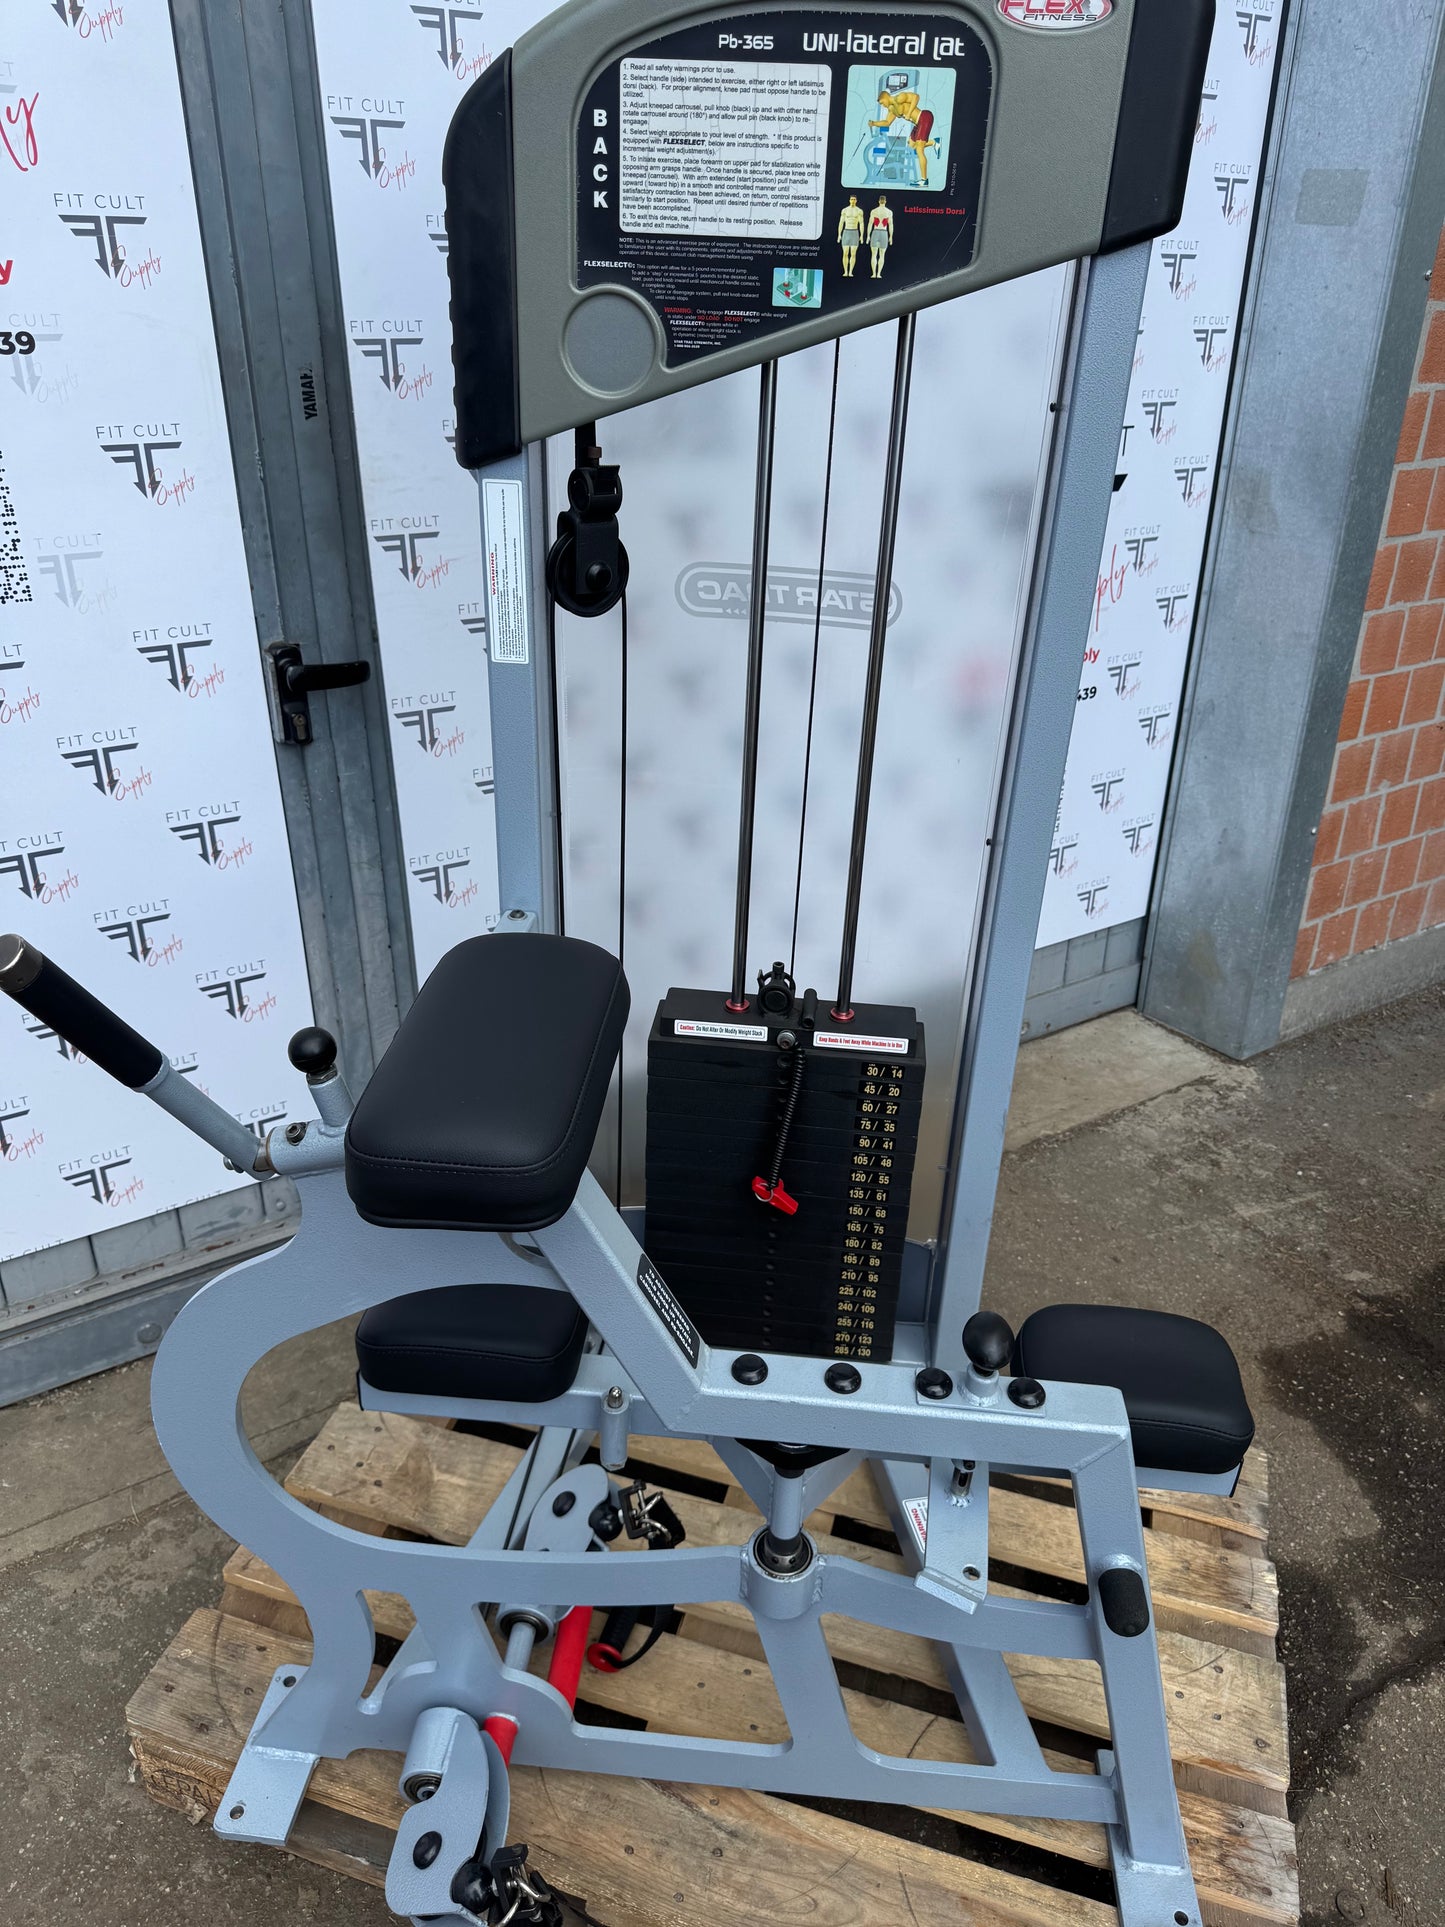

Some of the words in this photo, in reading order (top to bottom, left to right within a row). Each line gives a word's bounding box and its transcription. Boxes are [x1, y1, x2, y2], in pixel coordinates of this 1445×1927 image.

[718, 33, 774, 50] Pb-365
[803, 29, 926, 55] UNI-lateral
[630, 63, 646, 71] Read
[674, 65, 700, 73] warnings
[327, 96, 353, 111] FIT
[362, 98, 405, 114] CULT
[1214, 163, 1228, 173] FIT
[1230, 164, 1252, 174] CULT
[54, 193, 84, 208] FIT
[94, 195, 144, 210] CULT
[904, 206, 944, 214] Latissimus
[1161, 240, 1174, 249] FIT
[1177, 240, 1199, 250] CULT
[350, 320, 374, 333] FIT
[382, 320, 423, 332] CULT
[1193, 316, 1208, 325] FIT
[1210, 316, 1229, 325] CULT
[1142, 389, 1156, 398] FIT
[1159, 389, 1178, 398] CULT
[96, 425, 124, 439] FIT
[133, 423, 180, 437] CULT
[1174, 457, 1186, 465] FIT
[1189, 455, 1209, 464] CULT
[371, 519, 394, 531] FIT
[401, 515, 439, 528] CULT
[1125, 528, 1137, 536] FIT
[1140, 525, 1160, 535] CULT
[458, 603, 479, 615] FIT
[133, 629, 159, 642] FIT
[168, 623, 211, 638] CULT
[391, 696, 412, 709] FIT
[420, 691, 456, 705] CULT
[56, 734, 83, 749] FIT
[92, 727, 137, 743] CULT
[166, 809, 190, 823] FIT
[199, 801, 240, 817] CULT
[17, 831, 63, 849] CULT
[409, 855, 430, 867] FIT
[436, 847, 470, 862] CULT
[93, 909, 118, 923] FIT
[127, 899, 169, 916] CULT
[195, 970, 218, 984] FIT
[226, 960, 265, 976] CULT
[725, 1027, 737, 1035] Modify
[866, 1067, 879, 1078] 30
[891, 1070, 903, 1079] 14
[863, 1085, 876, 1095] 45
[888, 1088, 900, 1097] 20
[251, 1101, 287, 1119] CULT
[861, 1103, 874, 1113] 60
[885, 1106, 898, 1115] 27
[860, 1121, 872, 1131] 75
[883, 1123, 895, 1133] 35
[859, 1139, 871, 1148] 90
[882, 1141, 893, 1150] 41
[59, 1162, 83, 1174] FIT
[90, 1146, 130, 1163] CULT
[853, 1156, 869, 1166] 105
[880, 1159, 892, 1168] 48
[851, 1173, 867, 1183] 120
[878, 1176, 890, 1185] 55
[849, 1190, 864, 1199] 135
[876, 1193, 887, 1201] 61
[848, 1207, 864, 1216] 150
[875, 1210, 887, 1218] 68
[846, 1223, 862, 1232] 165
[873, 1226, 885, 1235] 75
[845, 1239, 860, 1248] 180
[871, 1242, 883, 1251] 82
[843, 1256, 858, 1265] 195
[869, 1258, 881, 1267] 89
[841, 1271, 857, 1280] 210
[868, 1274, 879, 1283] 95
[838, 1287, 854, 1296] 225
[862, 1289, 877, 1298] 102
[837, 1303, 853, 1312] 240
[861, 1305, 876, 1314] 109
[836, 1318, 852, 1328] 255
[860, 1321, 874, 1330] 116
[835, 1334, 851, 1343] 270
[858, 1336, 873, 1345] 123
[834, 1346, 849, 1355] 285
[857, 1349, 872, 1357] 130
